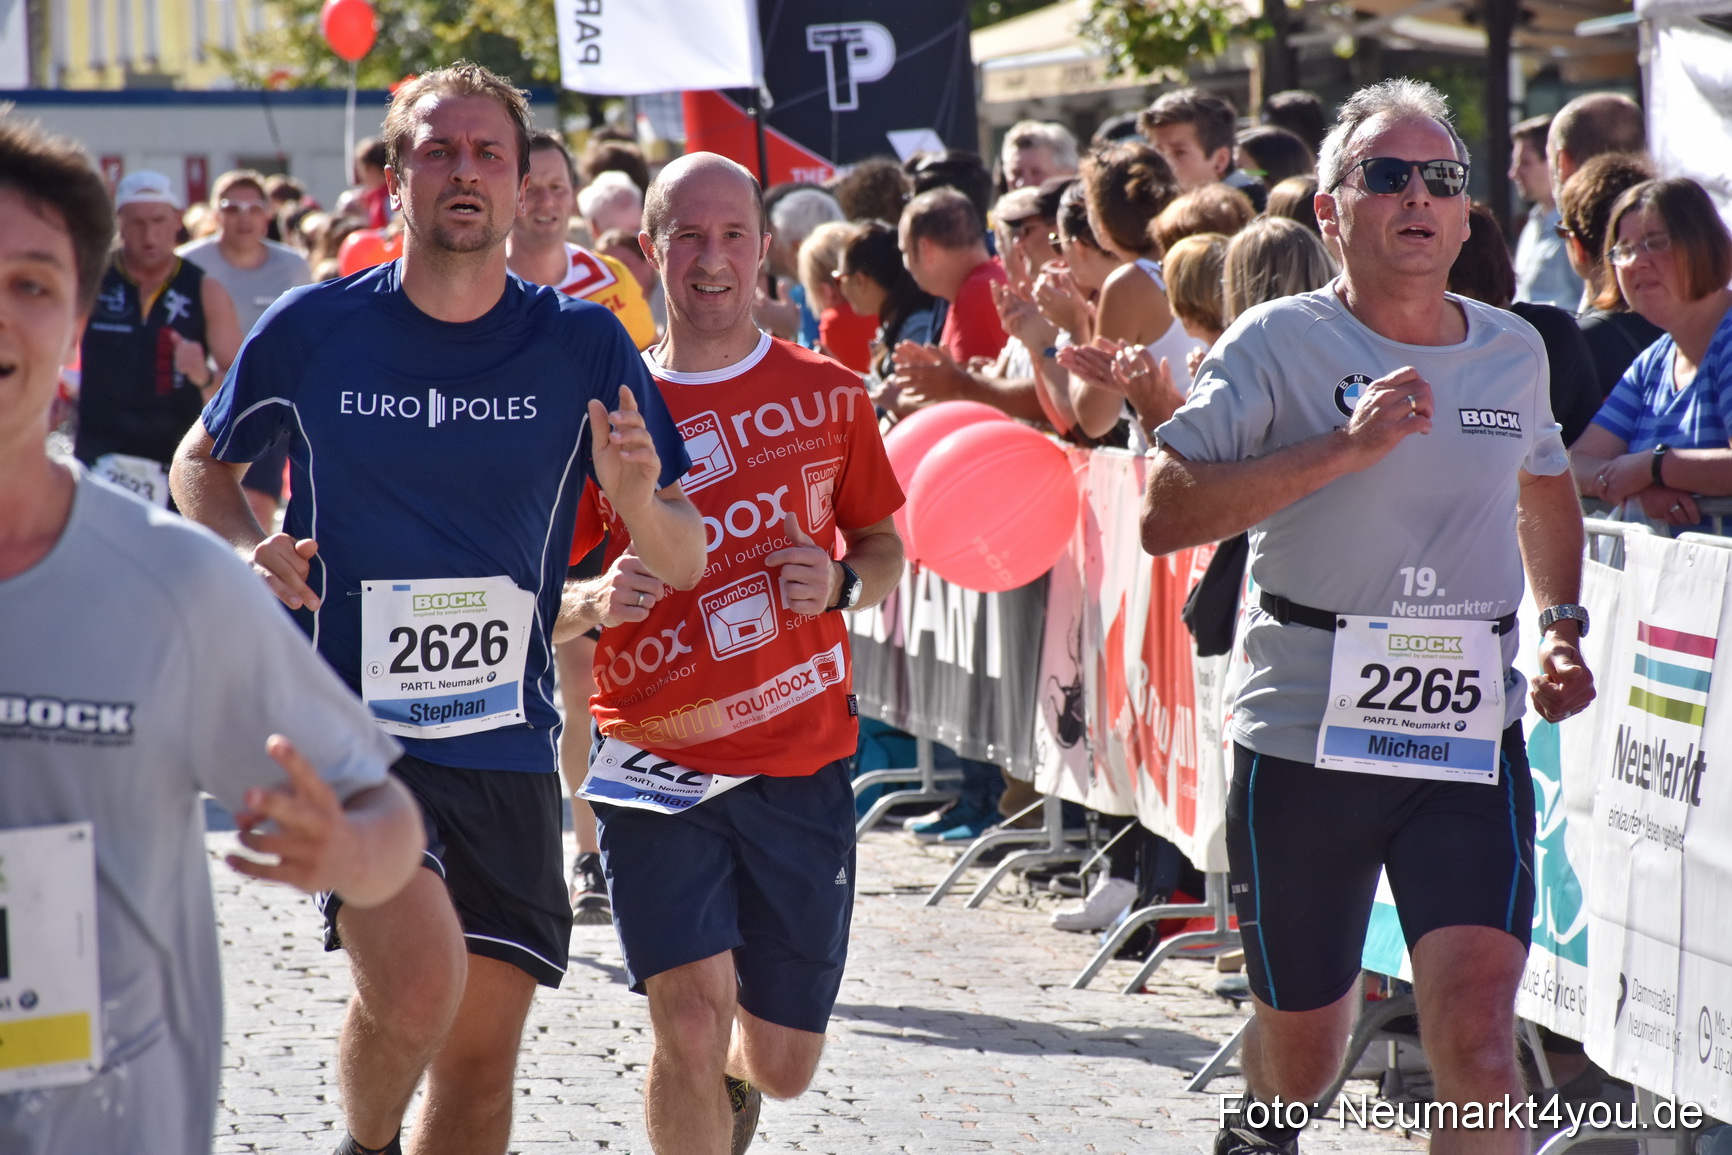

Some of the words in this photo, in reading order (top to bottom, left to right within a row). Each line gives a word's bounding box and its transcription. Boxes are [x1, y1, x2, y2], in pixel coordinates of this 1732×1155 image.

[340, 391, 421, 419] EURO
[452, 396, 538, 421] POLES
[1459, 408, 1521, 432] BOCK
[747, 436, 824, 469] schenken
[1400, 567, 1446, 597] 19.
[413, 591, 486, 612] BOCK
[704, 580, 767, 613] raumbox
[1391, 599, 1493, 617] Neumarkter
[389, 619, 509, 674] 2626
[1388, 634, 1464, 653] BOCK
[401, 682, 436, 691] PARTL
[439, 677, 484, 690] Neumarkt
[726, 669, 815, 721] raumbox
[1356, 663, 1482, 714] 2265
[0, 693, 135, 735] BOCK
[409, 698, 486, 723] Stephan
[733, 712, 766, 730] schenken
[769, 700, 792, 716] wohnen
[796, 687, 817, 702] outdoor
[1362, 715, 1399, 727] PARTL
[1401, 718, 1450, 730] Neumarkt
[1368, 734, 1450, 762] Michael
[635, 791, 693, 808] Tobias
[658, 785, 704, 794] Neumarkt
